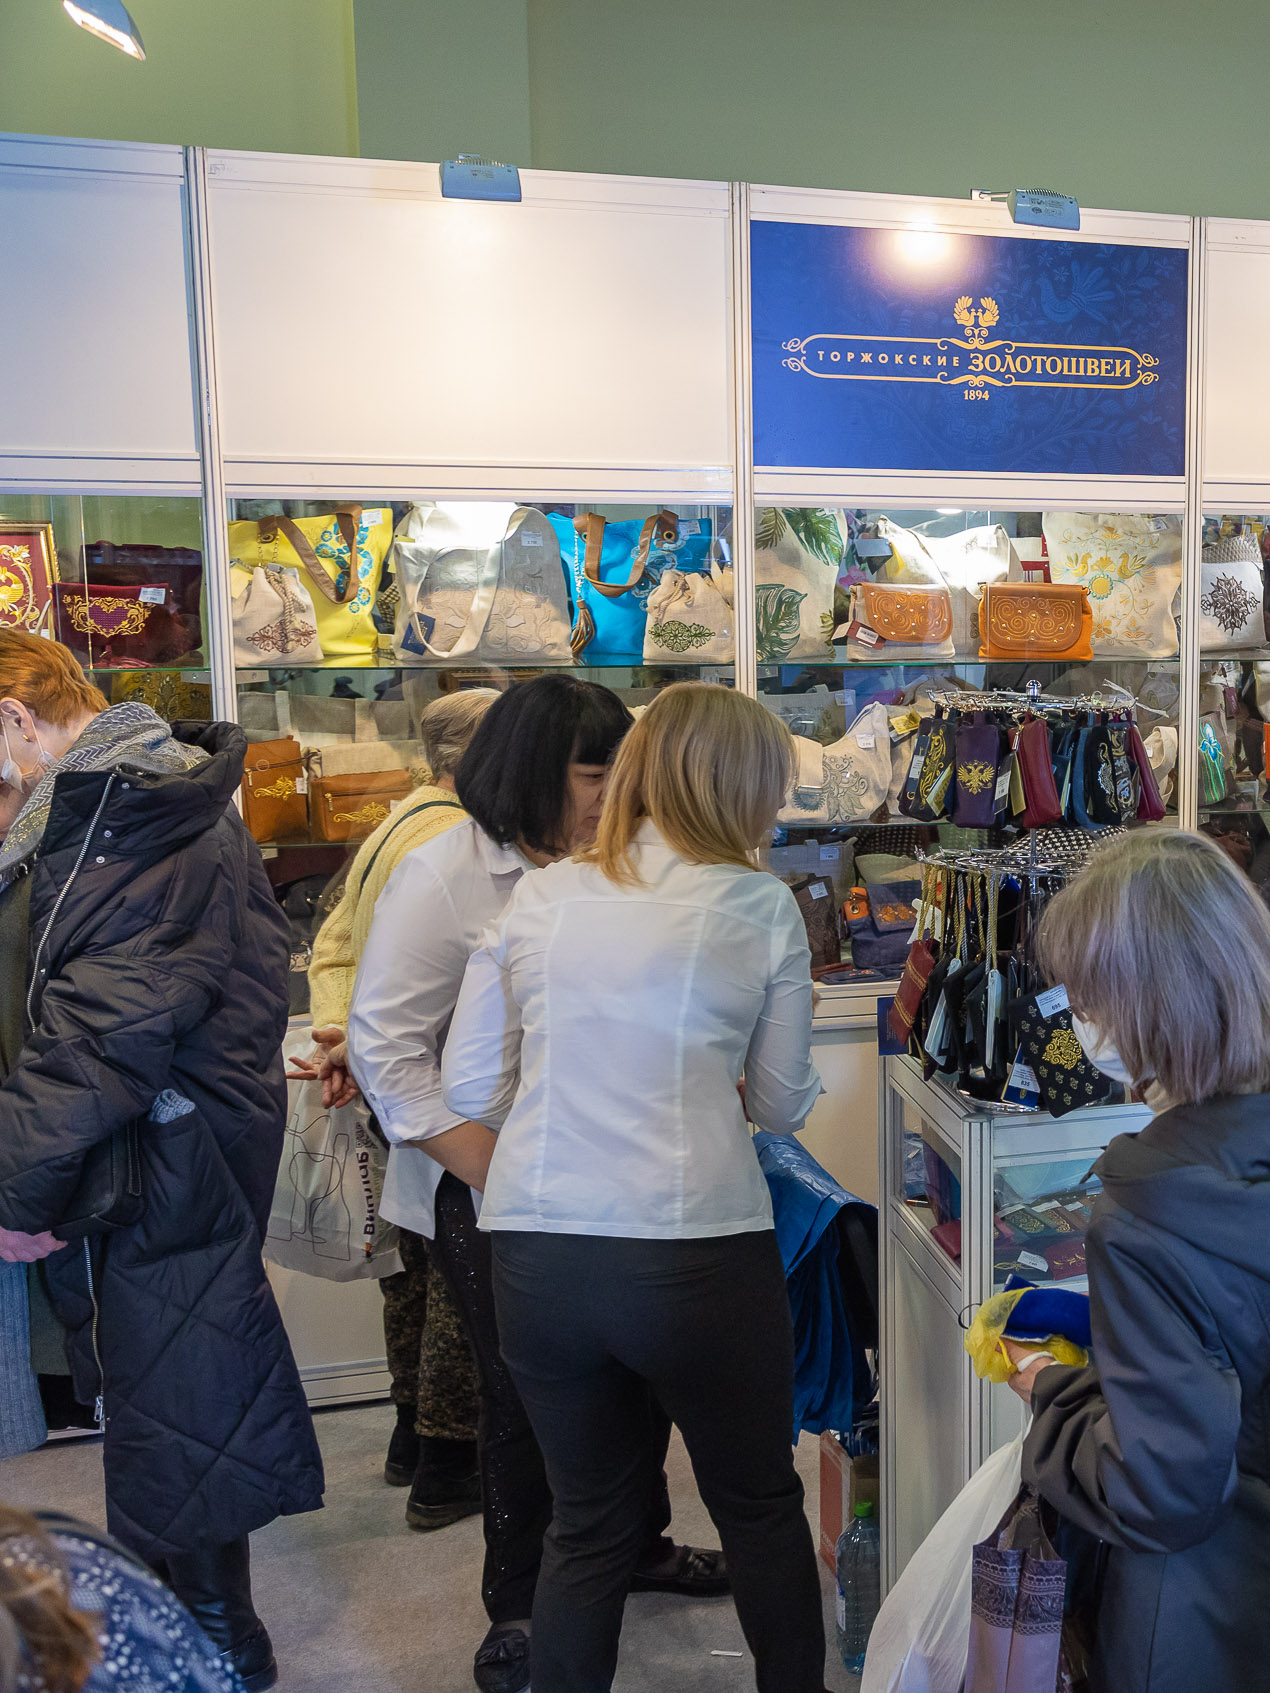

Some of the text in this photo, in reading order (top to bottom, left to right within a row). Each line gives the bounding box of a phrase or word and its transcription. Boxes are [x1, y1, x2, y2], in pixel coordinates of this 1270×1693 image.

[817, 350, 1131, 378] ТОРЖОКСКИЕ ЗОЛОТОШВЕИ
[963, 389, 990, 401] 1894
